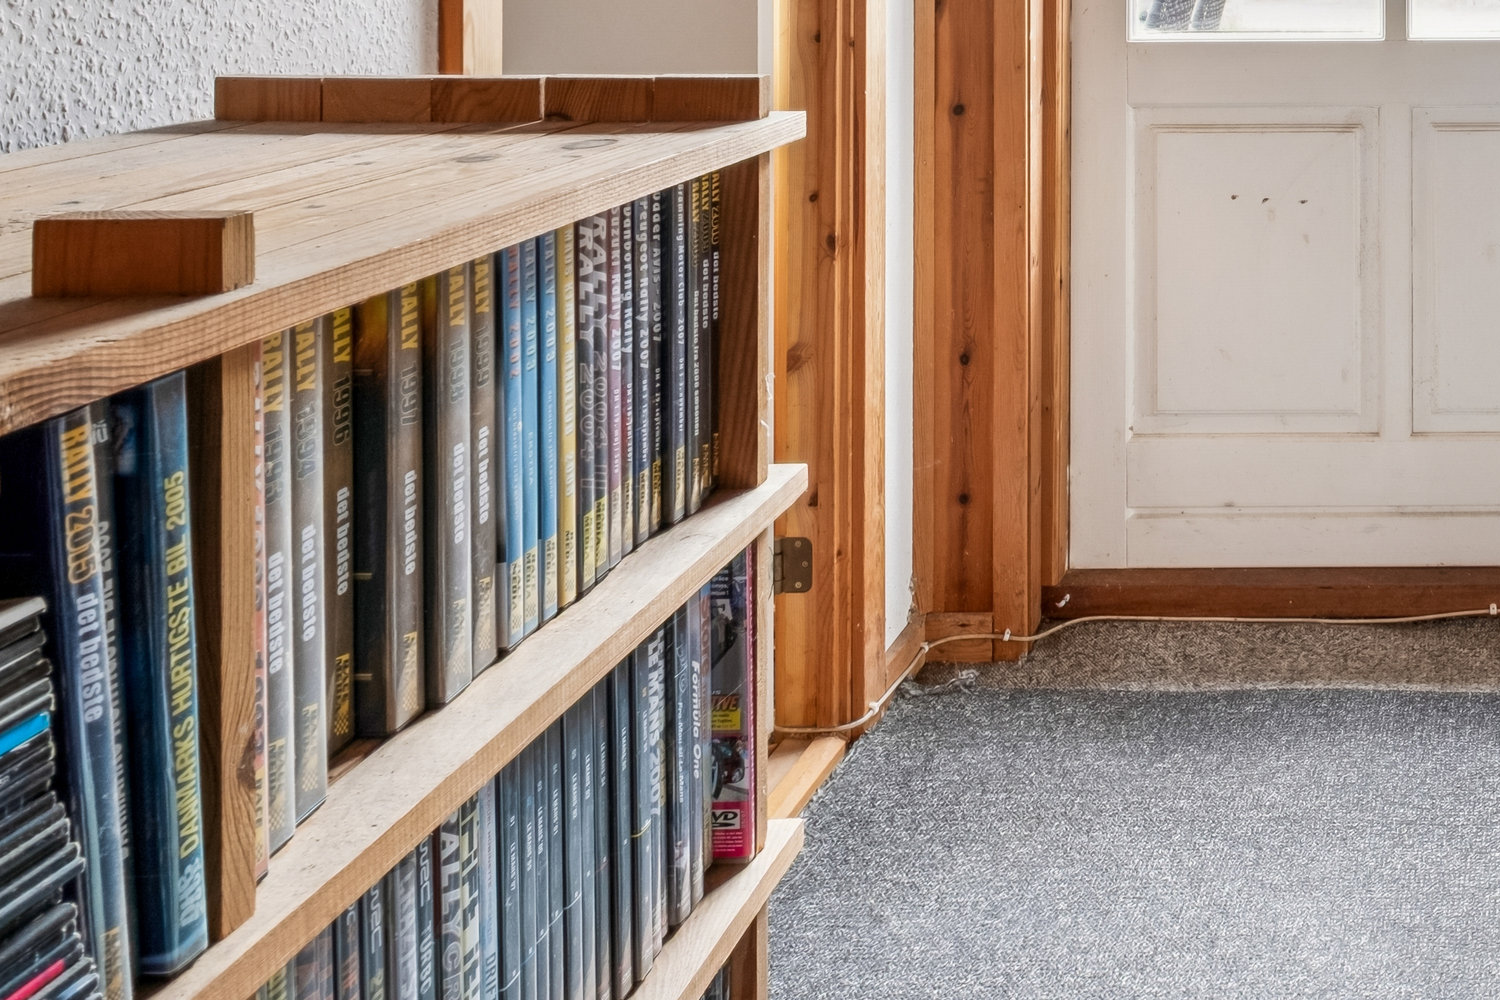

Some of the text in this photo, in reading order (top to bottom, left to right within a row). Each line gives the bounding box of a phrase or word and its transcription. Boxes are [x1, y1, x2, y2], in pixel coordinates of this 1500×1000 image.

[544, 235, 556, 296] RALLY
[610, 207, 621, 267] Suzuki
[636, 200, 649, 272] Peugeot
[652, 247, 662, 284] Avis
[677, 245, 685, 278] Motor
[525, 240, 536, 304] RALLY
[593, 216, 608, 338] RALLY
[608, 272, 621, 324] Rally
[635, 276, 649, 322] Rally
[677, 281, 685, 306] Club
[579, 225, 595, 462] RALLY 2004
[611, 327, 621, 371] 2007
[622, 307, 633, 354] Rally
[640, 328, 649, 369] 2007
[652, 301, 662, 343] 2007
[331, 372, 351, 447] 1996
[400, 359, 419, 427] 1997
[594, 350, 608, 449] 2004
[452, 441, 466, 474] det
[477, 425, 489, 457] det
[335, 486, 350, 524] det
[403, 469, 418, 505] det
[453, 475, 466, 545] bedste
[478, 458, 491, 525] bedste
[60, 422, 106, 724] RALLY 2015 det bedste
[267, 551, 285, 591] det
[301, 523, 317, 562] det
[336, 525, 350, 596] bedste
[403, 508, 418, 576] bedste
[268, 593, 286, 676] bedste
[302, 565, 319, 643] bedste
[163, 470, 201, 859] DANMARKS HURTIGSTE BIL 2005
[648, 639, 661, 817] LE MANS 2007
[690, 659, 702, 780] Formula One
[370, 886, 383, 954] WRC
[419, 836, 435, 995] WRC TURBO
